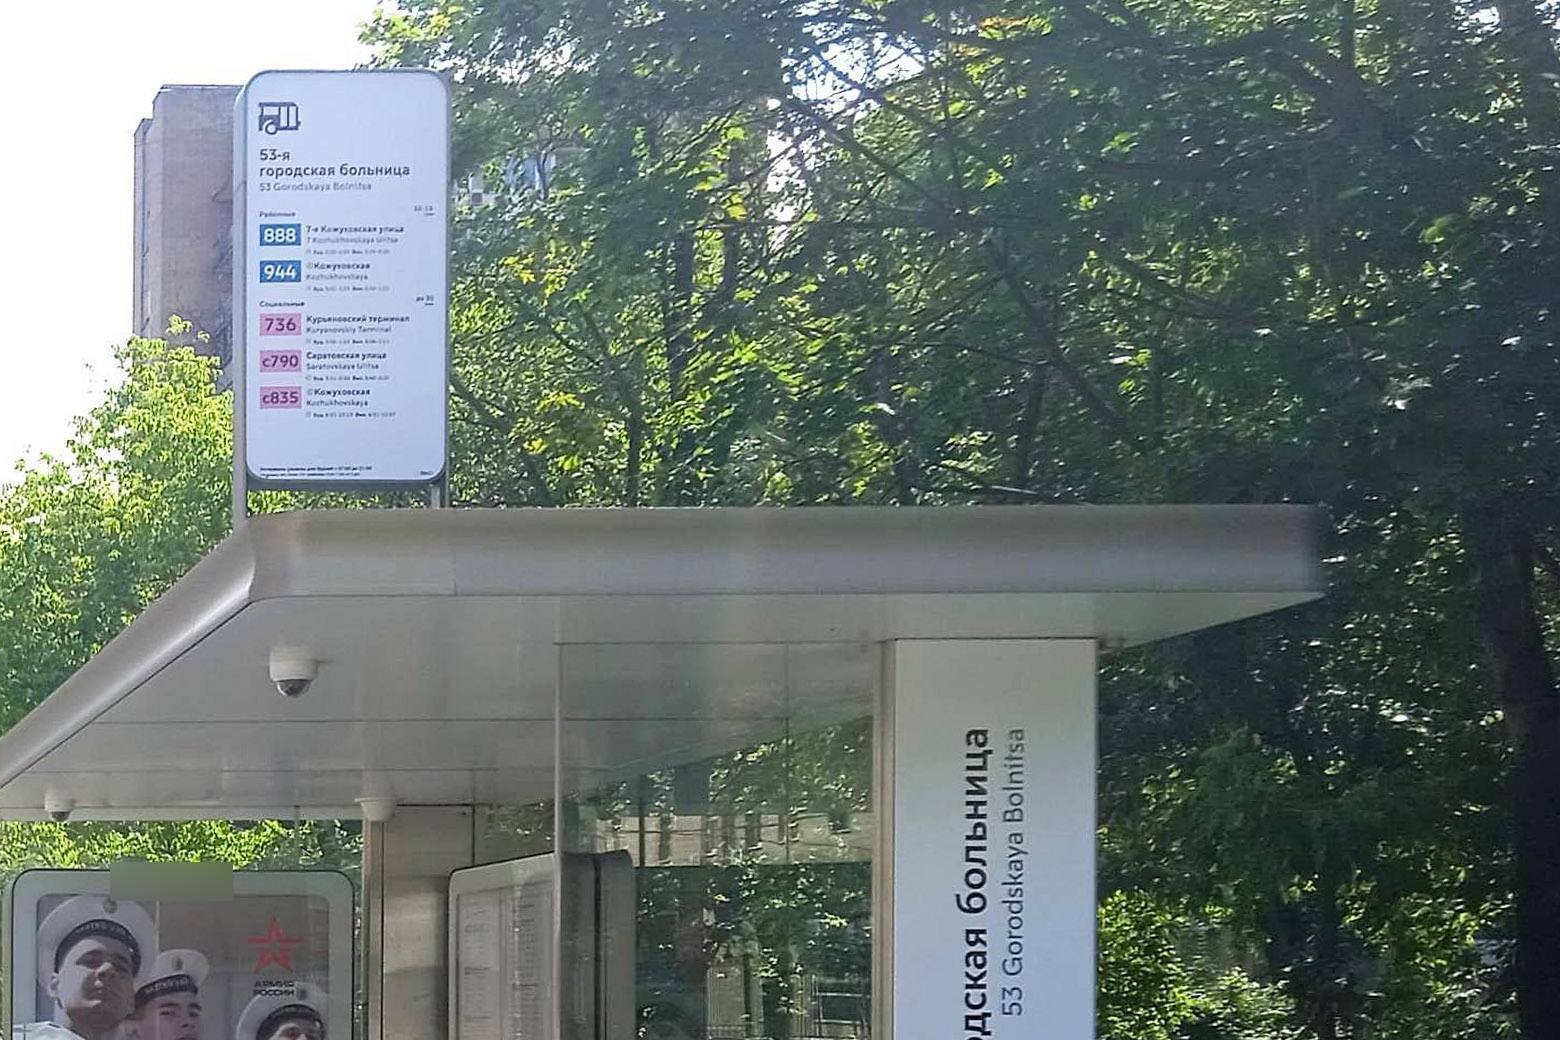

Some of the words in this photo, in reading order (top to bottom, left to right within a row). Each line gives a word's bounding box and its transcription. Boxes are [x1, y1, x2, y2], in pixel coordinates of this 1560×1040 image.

[259, 149, 290, 161] 53-я
[259, 166, 336, 179] городская
[340, 163, 410, 177] больница
[259, 182, 271, 191] 53
[263, 228, 297, 243] 888
[263, 264, 297, 280] 944
[265, 317, 297, 332] 736
[262, 354, 299, 369] с790
[262, 391, 299, 406] с835
[314, 388, 370, 398] Кожуховская
[1001, 729, 1024, 823] Bolnitsa
[955, 729, 993, 914] больница
[1001, 832, 1029, 976] Gorodskaya
[1001, 986, 1023, 1016] 53
